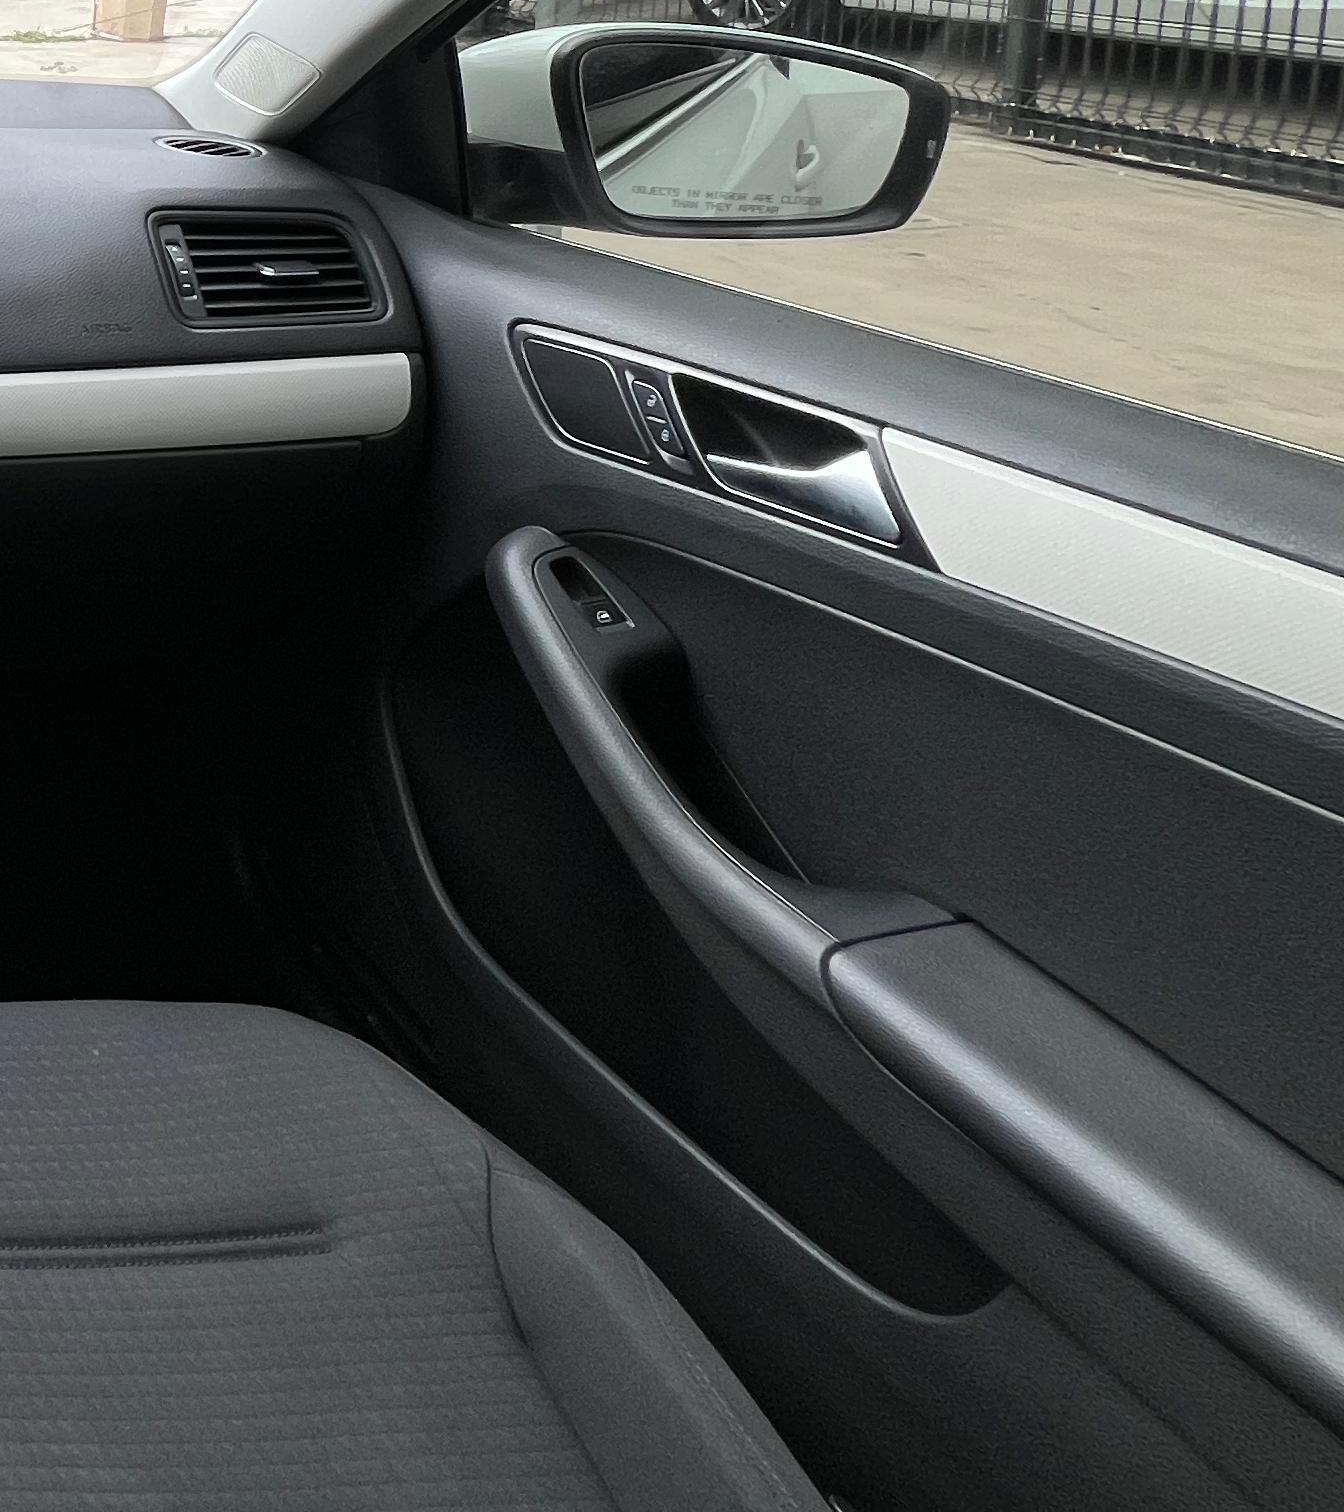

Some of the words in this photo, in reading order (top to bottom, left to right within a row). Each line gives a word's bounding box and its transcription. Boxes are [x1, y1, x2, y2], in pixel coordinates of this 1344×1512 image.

[631, 185, 681, 197] OBJECTS
[687, 189, 700, 198] IN
[705, 191, 749, 201] MIRROR
[753, 194, 775, 204] ARE
[781, 195, 824, 206] CLOSER
[671, 199, 699, 209] THAN
[705, 201, 733, 211] THEY
[738, 204, 780, 214] APPEAR
